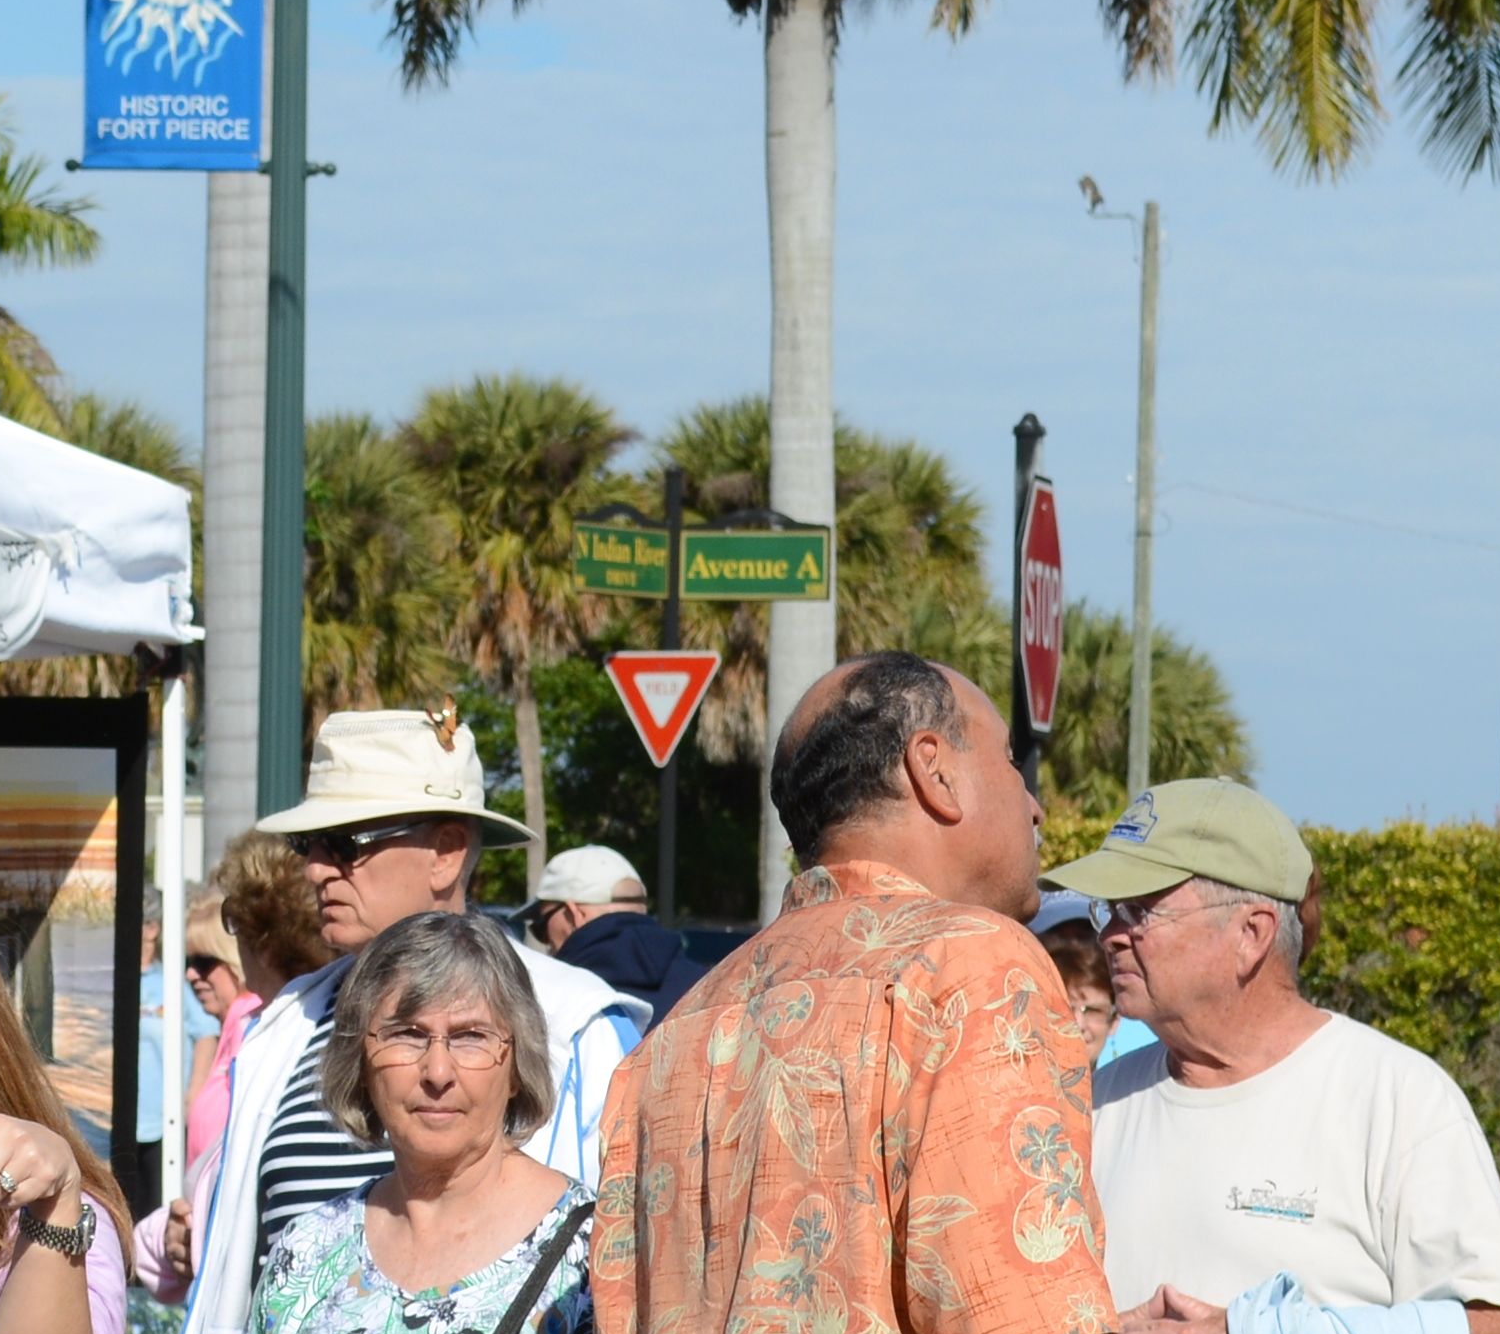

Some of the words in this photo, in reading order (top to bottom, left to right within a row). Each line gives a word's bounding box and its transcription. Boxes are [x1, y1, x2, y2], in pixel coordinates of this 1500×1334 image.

[120, 94, 229, 117] HISTORIC
[97, 118, 161, 139] FORT
[165, 118, 250, 140] PIERCE
[576, 530, 589, 559] N
[592, 533, 632, 564] Indian
[634, 537, 667, 567] River
[687, 551, 788, 580] Avenue
[796, 551, 820, 580] A
[1026, 558, 1059, 651] STOP
